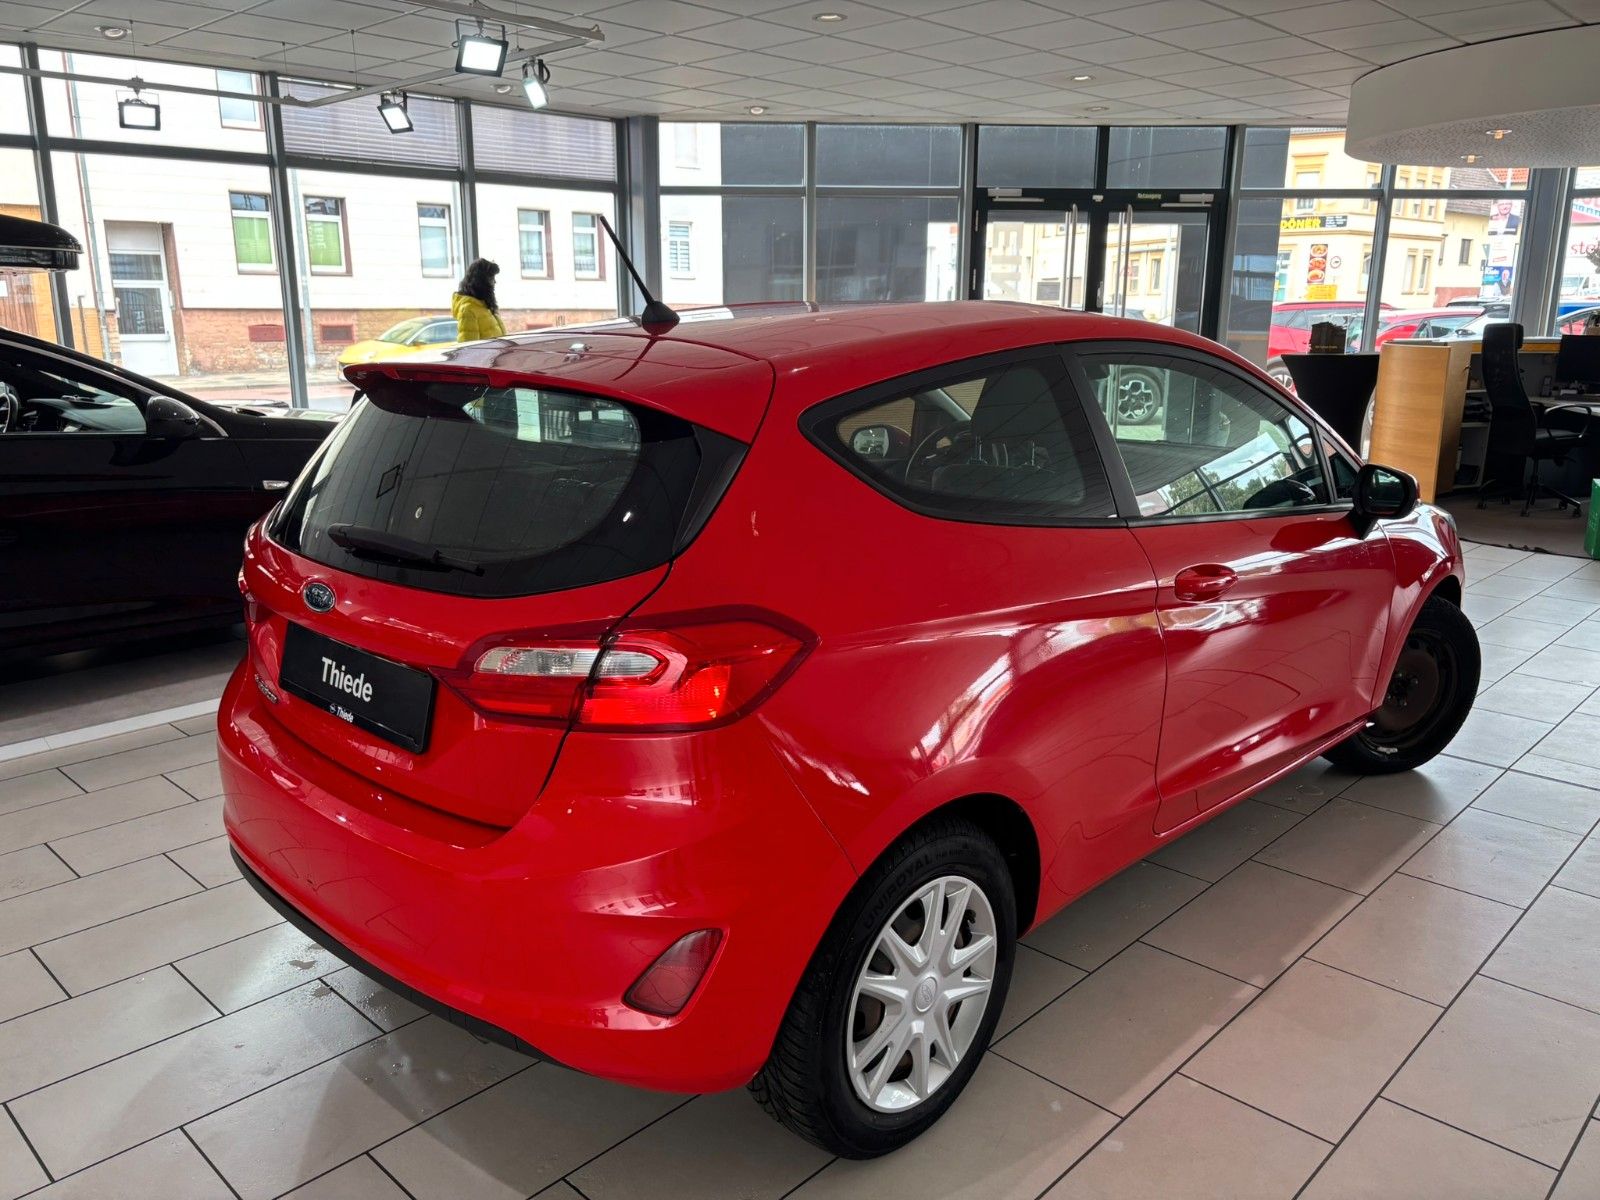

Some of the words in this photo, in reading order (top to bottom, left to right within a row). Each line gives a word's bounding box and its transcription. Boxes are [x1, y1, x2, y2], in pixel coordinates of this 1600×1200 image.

[1280, 216, 1321, 229] DÖNER
[321, 656, 373, 702] Thiede
[336, 706, 354, 723] Thiede
